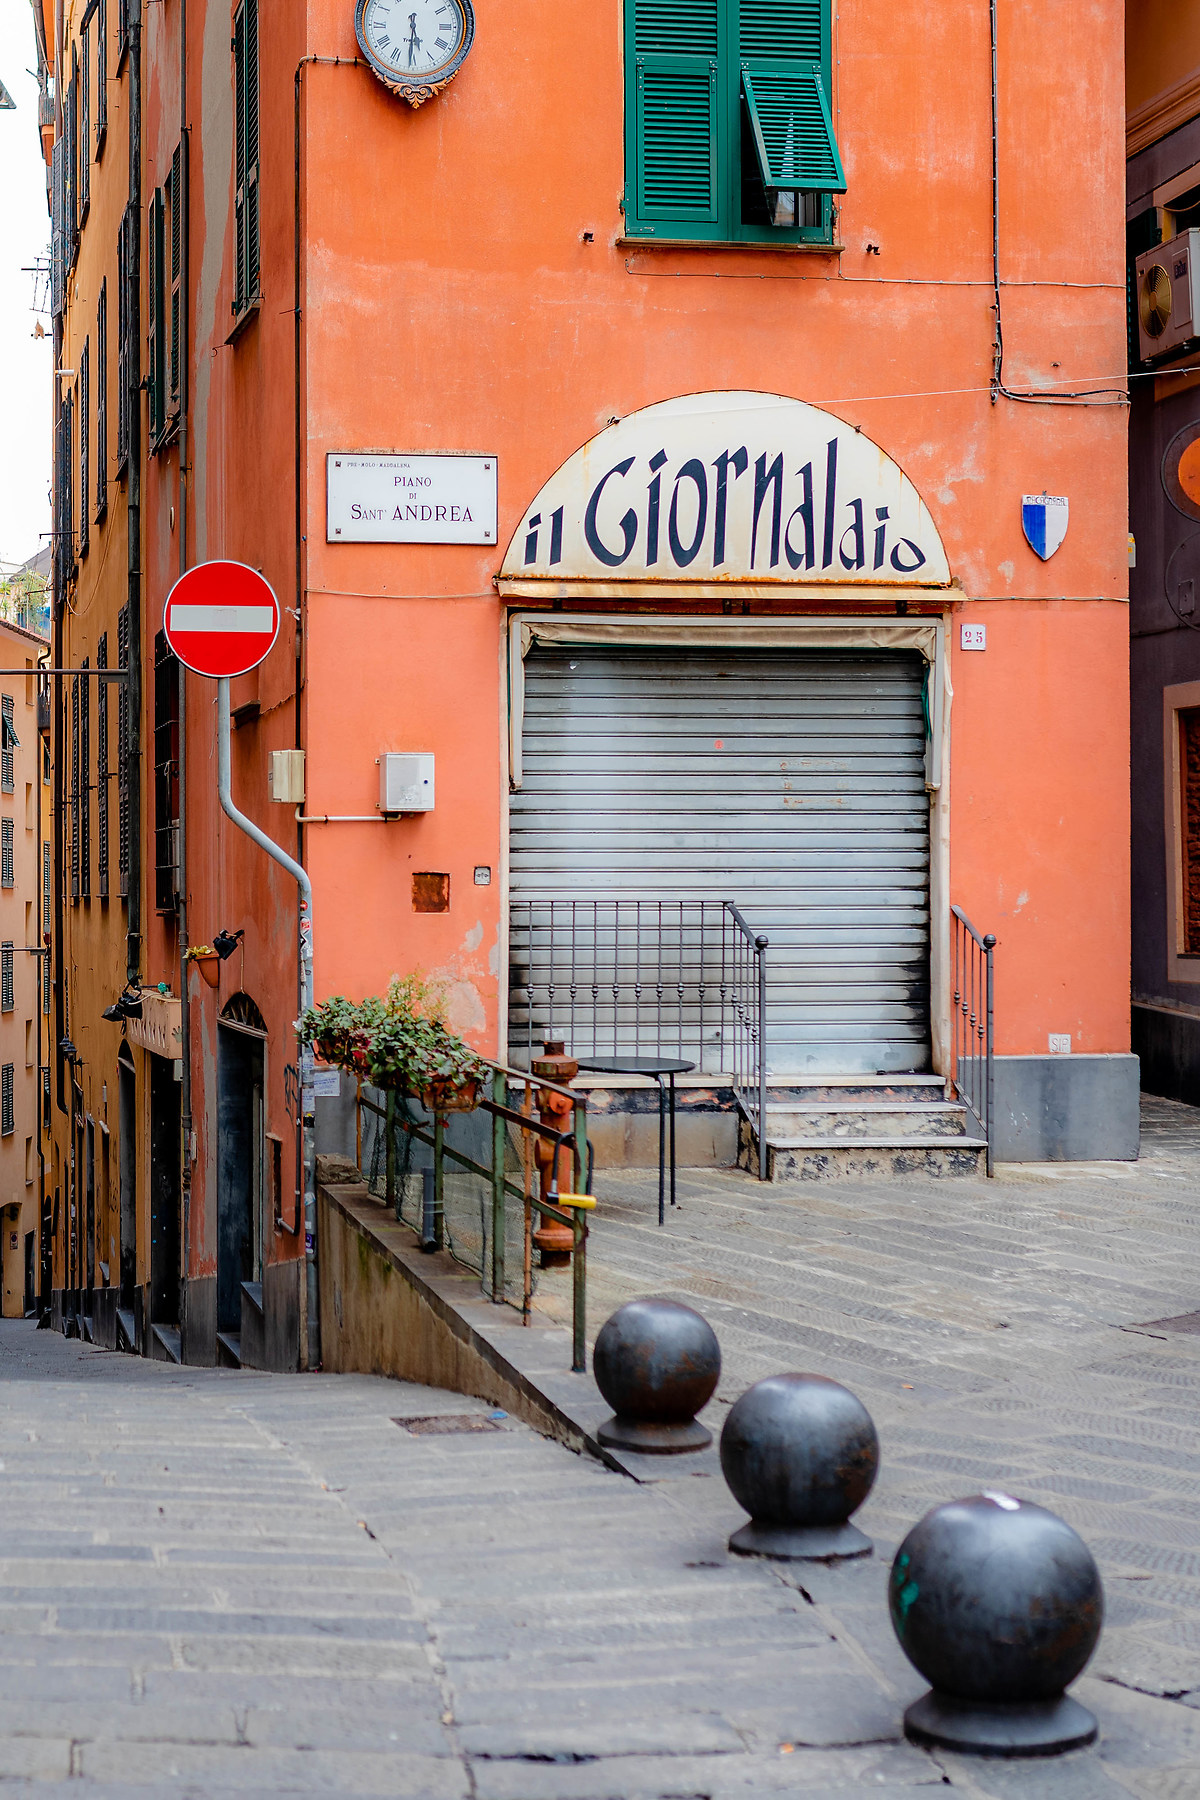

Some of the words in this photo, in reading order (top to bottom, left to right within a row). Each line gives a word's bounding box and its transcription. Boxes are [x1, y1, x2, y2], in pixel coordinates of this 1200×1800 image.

[393, 476, 432, 487] PIANO
[408, 492, 417, 500] DI
[524, 504, 564, 566] il
[584, 436, 927, 573] Giornalaio
[392, 504, 474, 523] ANDREA
[964, 631, 983, 643] 25
